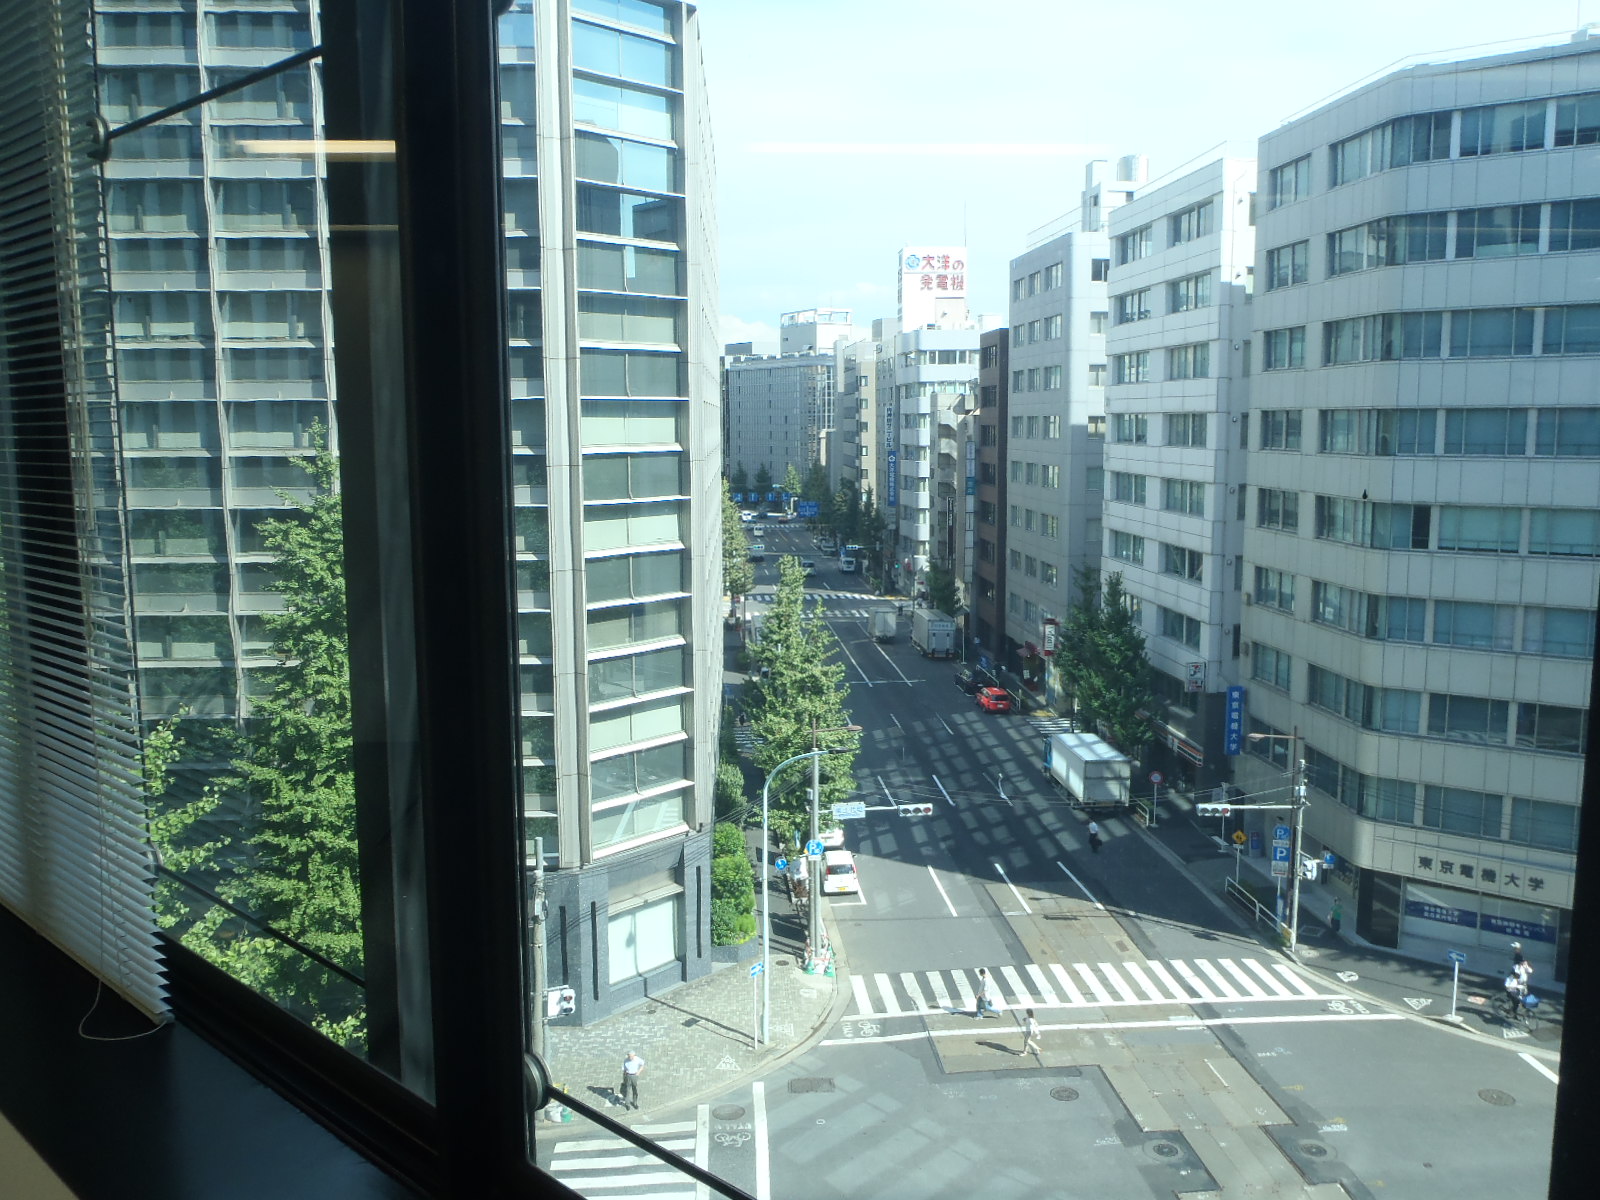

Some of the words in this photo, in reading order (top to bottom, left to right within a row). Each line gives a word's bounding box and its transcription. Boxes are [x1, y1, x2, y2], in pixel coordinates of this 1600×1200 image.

[921, 254, 964, 270] 大洋の
[920, 274, 964, 290] 発電機
[1229, 691, 1240, 751] 東京電機大学
[1276, 848, 1286, 860] P
[1418, 855, 1545, 892] 東京電機大学
